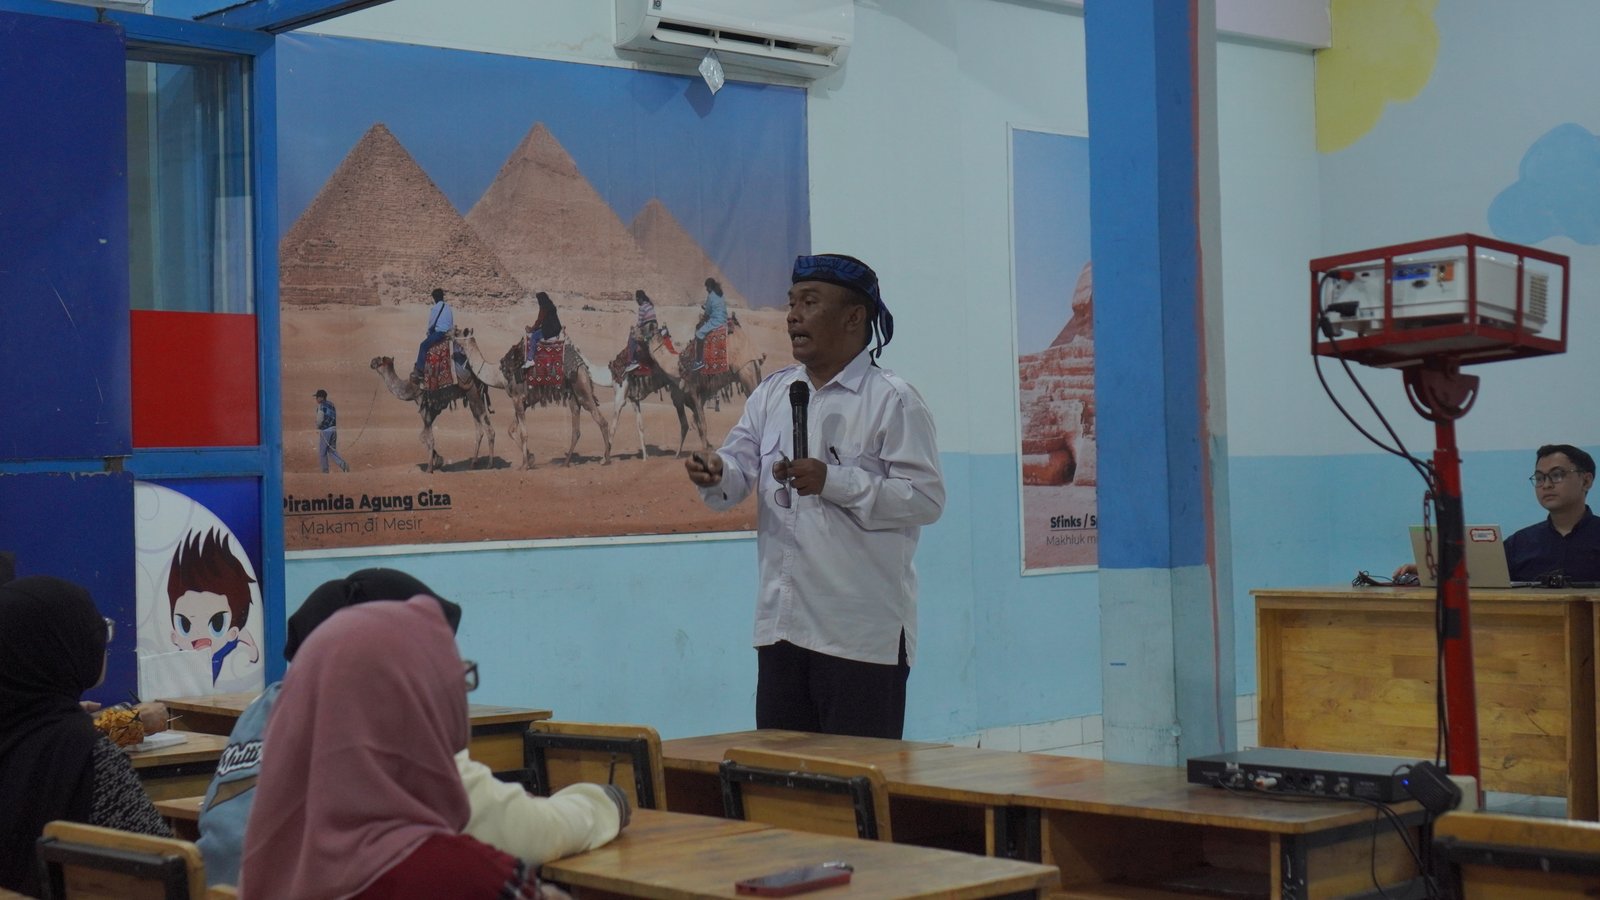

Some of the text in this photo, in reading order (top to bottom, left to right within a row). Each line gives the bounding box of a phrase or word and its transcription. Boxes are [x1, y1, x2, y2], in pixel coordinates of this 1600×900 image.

[359, 493, 413, 512] Agung
[417, 490, 452, 507] Giza
[301, 517, 423, 535] Makam di Mesir
[1050, 515, 1082, 529] Sfinks
[1090, 515, 1098, 527] S
[1046, 534, 1097, 546] Makhluk m
